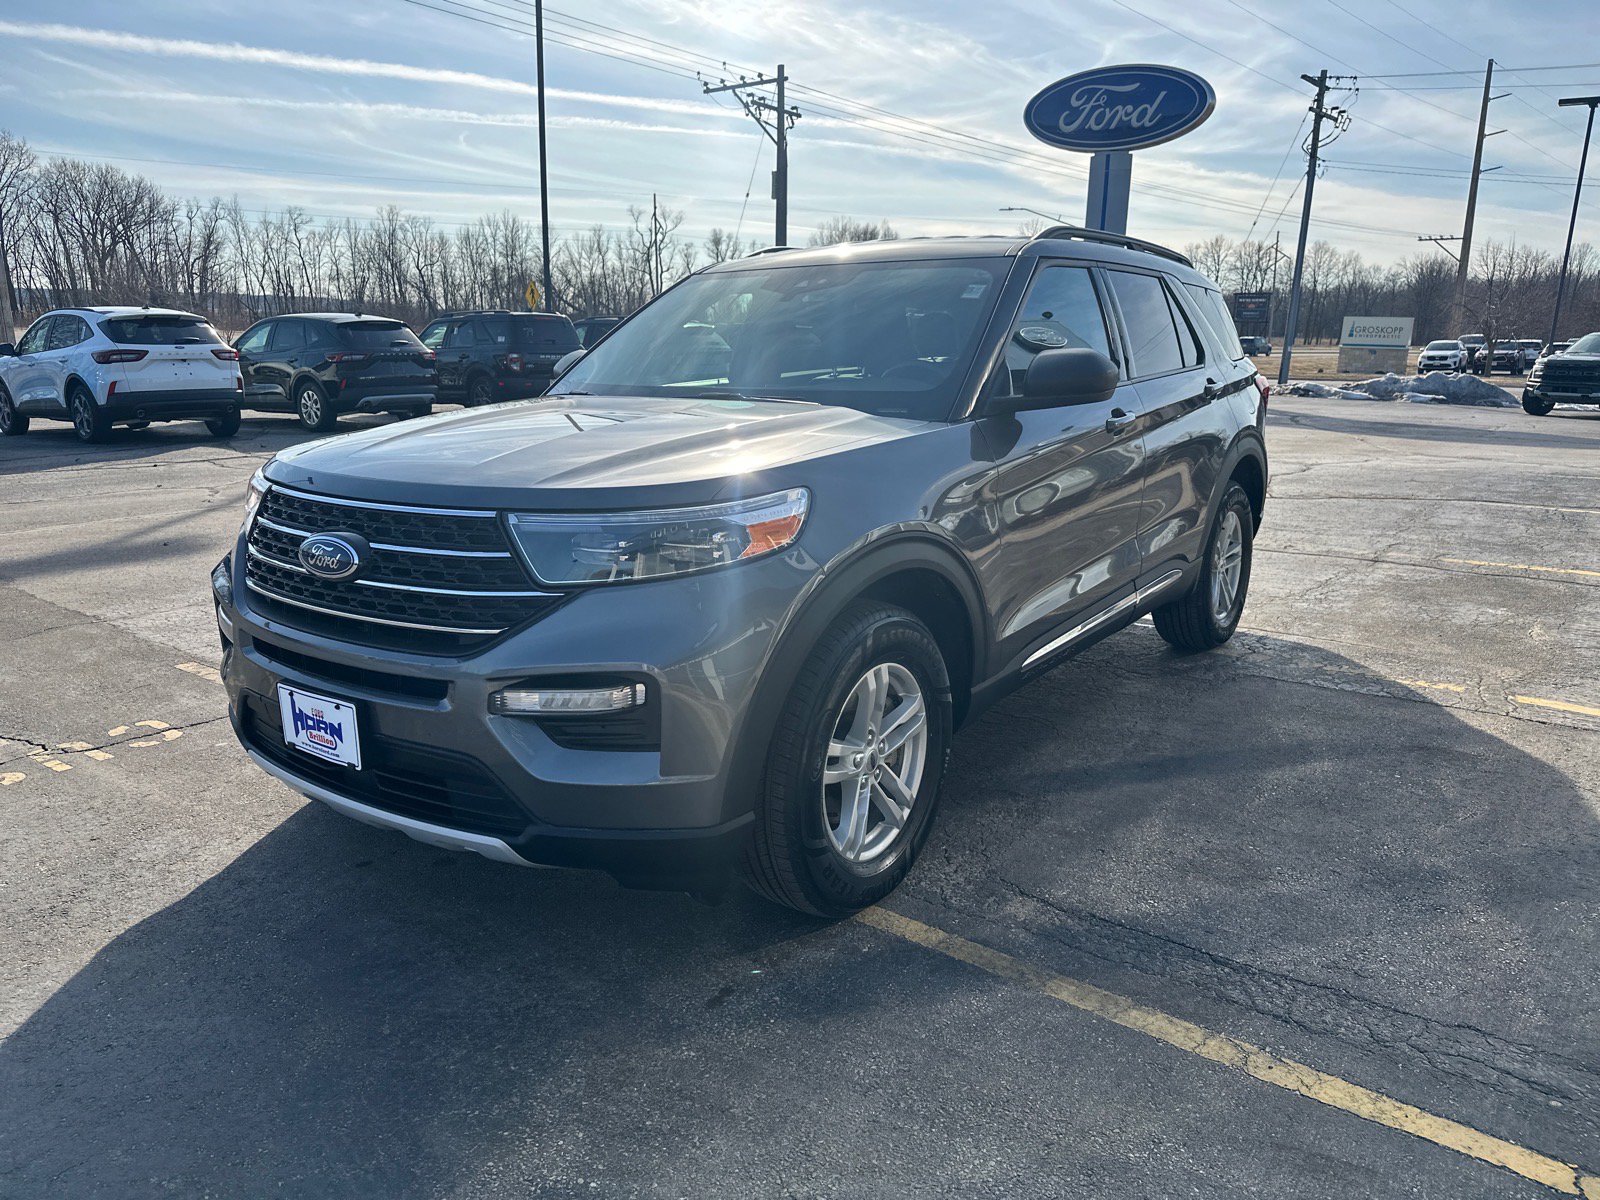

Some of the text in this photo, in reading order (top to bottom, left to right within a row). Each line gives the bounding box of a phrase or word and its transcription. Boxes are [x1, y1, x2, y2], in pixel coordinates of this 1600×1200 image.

[1058, 82, 1168, 133] Ford
[1354, 326, 1404, 334] GROSKOPP
[308, 543, 342, 569] Ford
[290, 693, 344, 744] HORN
[309, 731, 335, 746] Brillion
